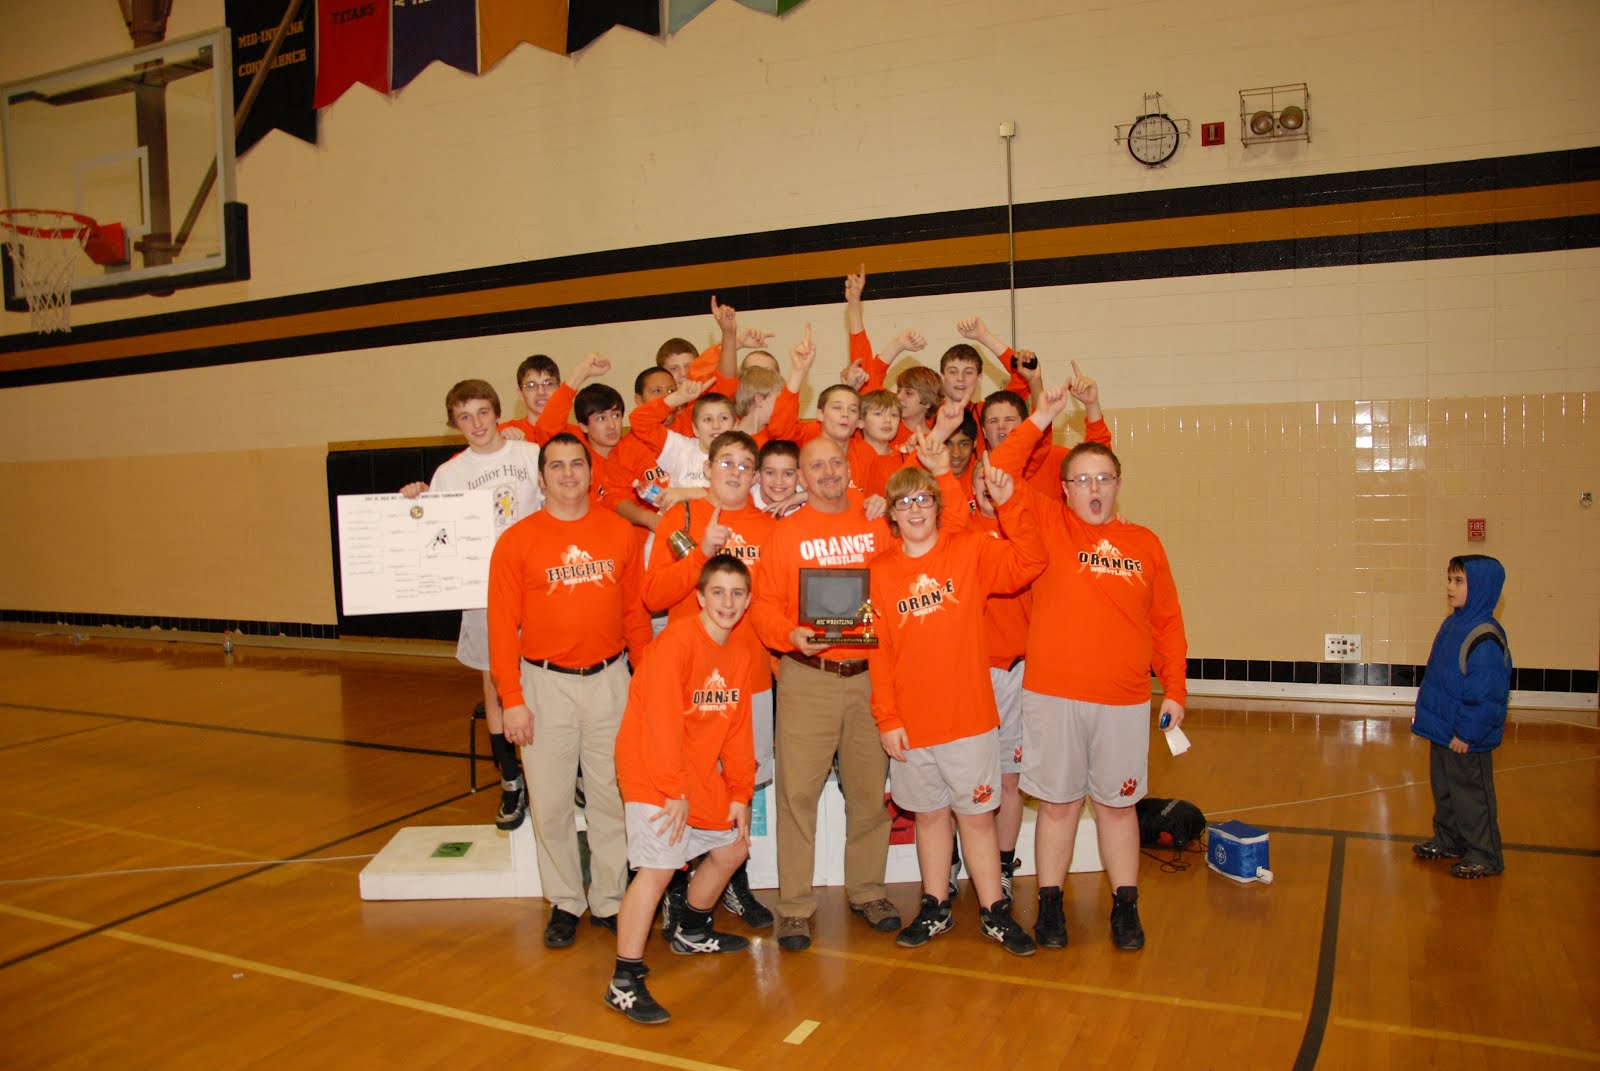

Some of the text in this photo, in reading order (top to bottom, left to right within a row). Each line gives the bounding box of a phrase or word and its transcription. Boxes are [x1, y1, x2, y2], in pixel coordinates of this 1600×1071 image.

[331, 4, 375, 24] TITANS
[238, 21, 304, 48] MID-INNA
[238, 49, 307, 77] CONRENCE
[1469, 521, 1484, 531] FIRE
[800, 533, 875, 561] ORANGE
[547, 560, 615, 582] HEIGHTS
[817, 554, 865, 567] WRESTLING
[1078, 552, 1143, 572] ORANGE
[898, 580, 954, 614] ORANE
[912, 605, 940, 617] WREST
